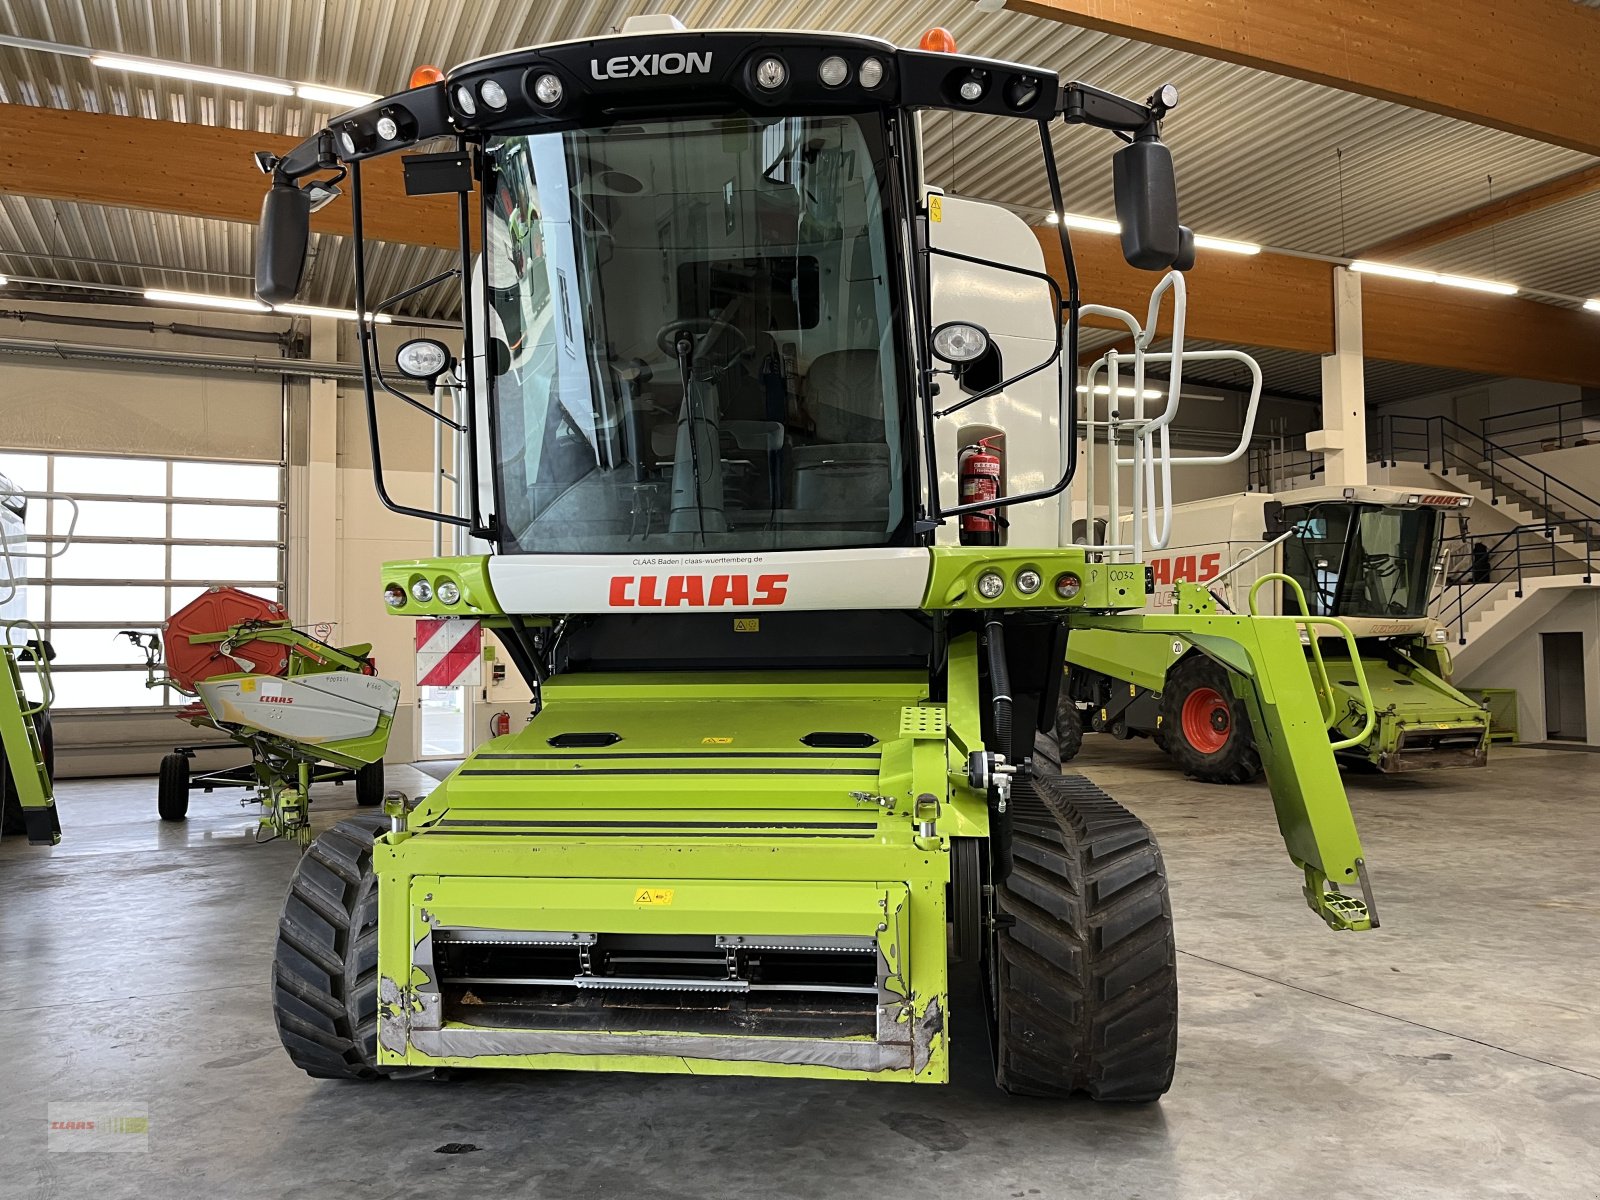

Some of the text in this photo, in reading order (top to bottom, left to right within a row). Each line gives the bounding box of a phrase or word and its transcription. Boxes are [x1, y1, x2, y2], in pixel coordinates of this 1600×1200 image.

[590, 51, 713, 81] LEXION
[1421, 495, 1462, 505] CLAAS
[632, 558, 656, 566] CLAAS
[1109, 569, 1135, 582] 0032
[1150, 553, 1221, 586] AAS
[608, 574, 790, 607] CLAAS
[259, 695, 294, 704] CLAAS
